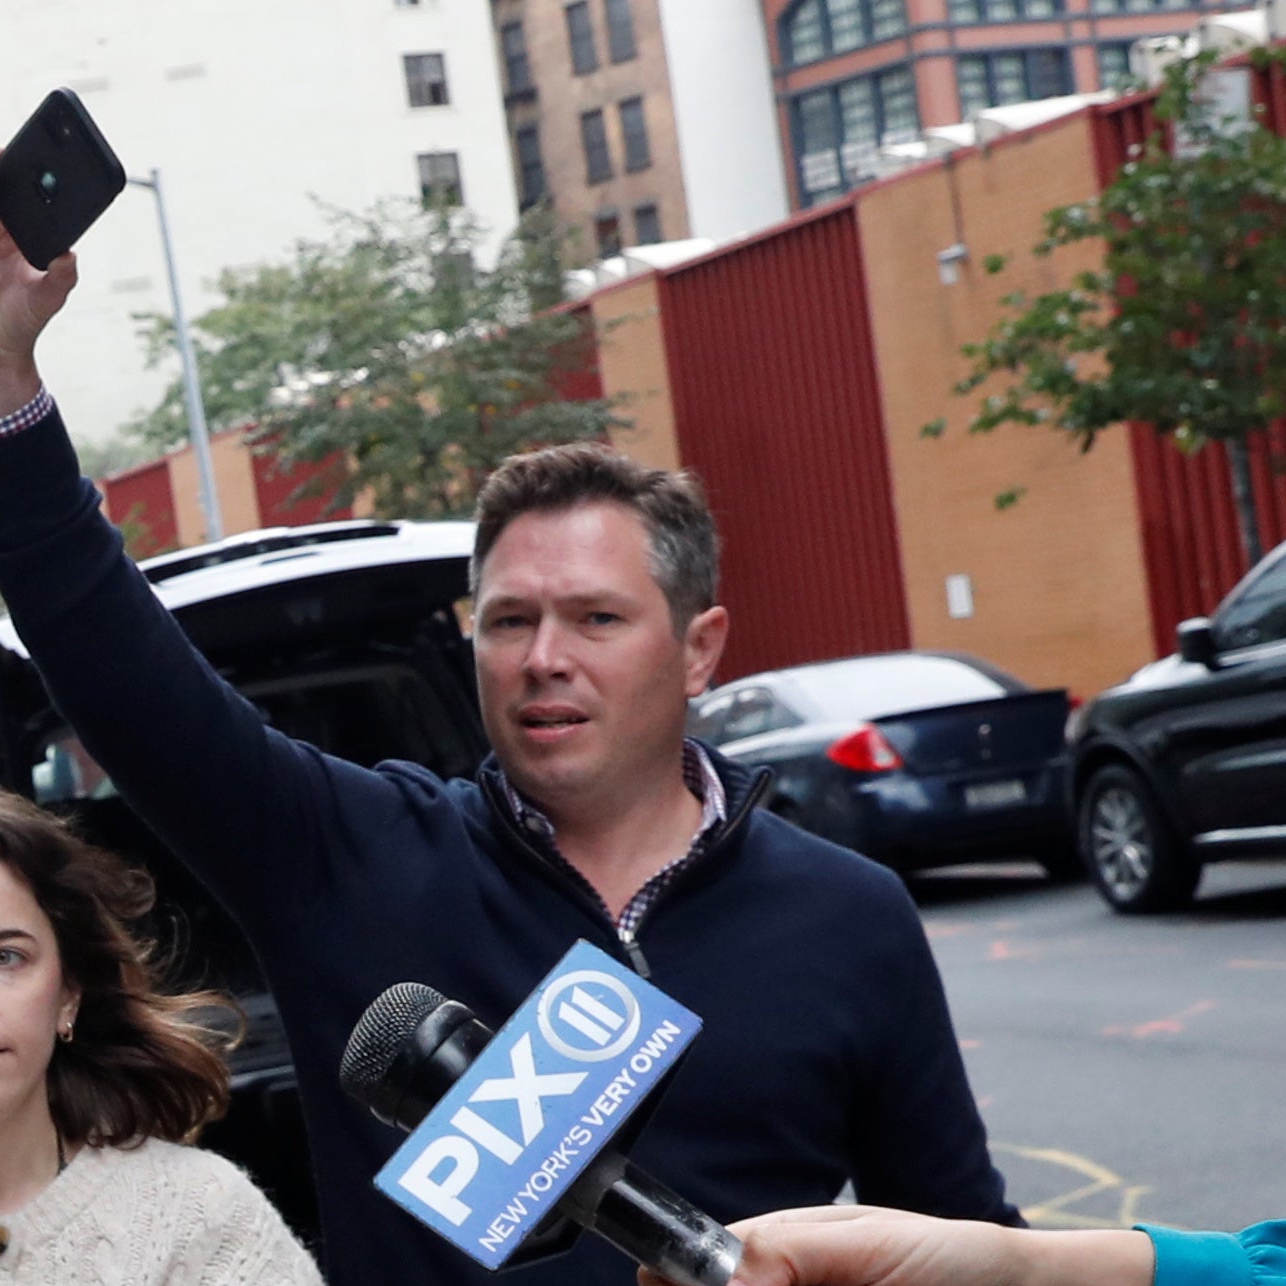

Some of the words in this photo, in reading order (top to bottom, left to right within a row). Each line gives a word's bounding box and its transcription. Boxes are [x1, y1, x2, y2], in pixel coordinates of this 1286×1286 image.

[397, 1031, 589, 1228] PIX
[478, 1198, 528, 1253] NEW
[518, 1124, 593, 1200] YORK'S
[580, 1070, 637, 1128] VERY
[635, 1019, 681, 1075] OWN
